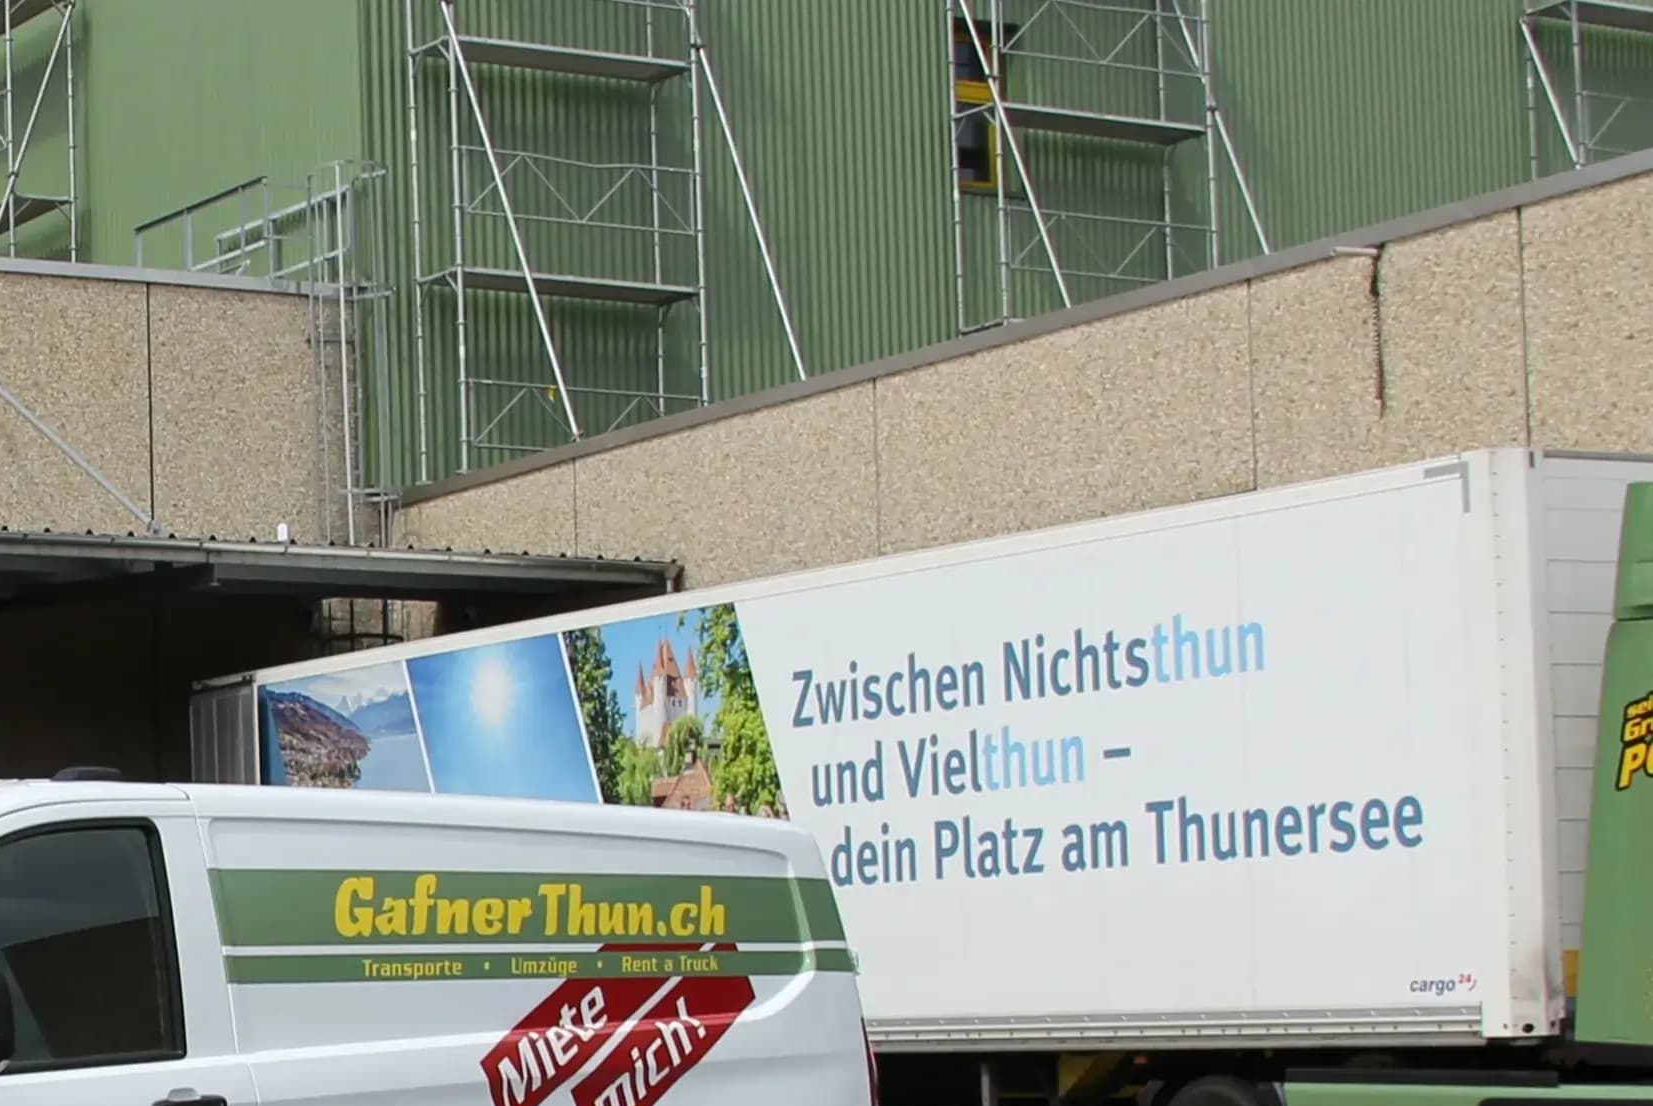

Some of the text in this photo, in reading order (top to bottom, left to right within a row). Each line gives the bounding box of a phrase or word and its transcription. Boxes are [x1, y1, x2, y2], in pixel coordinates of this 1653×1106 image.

[791, 613, 1265, 728] Zwischen Nichtsthun
[811, 740, 885, 807] und
[897, 725, 1086, 798] Vielthun
[830, 794, 1424, 887] dein Platz am Thunersee
[362, 955, 720, 980] Transporte Umzüge Rent a Truck
